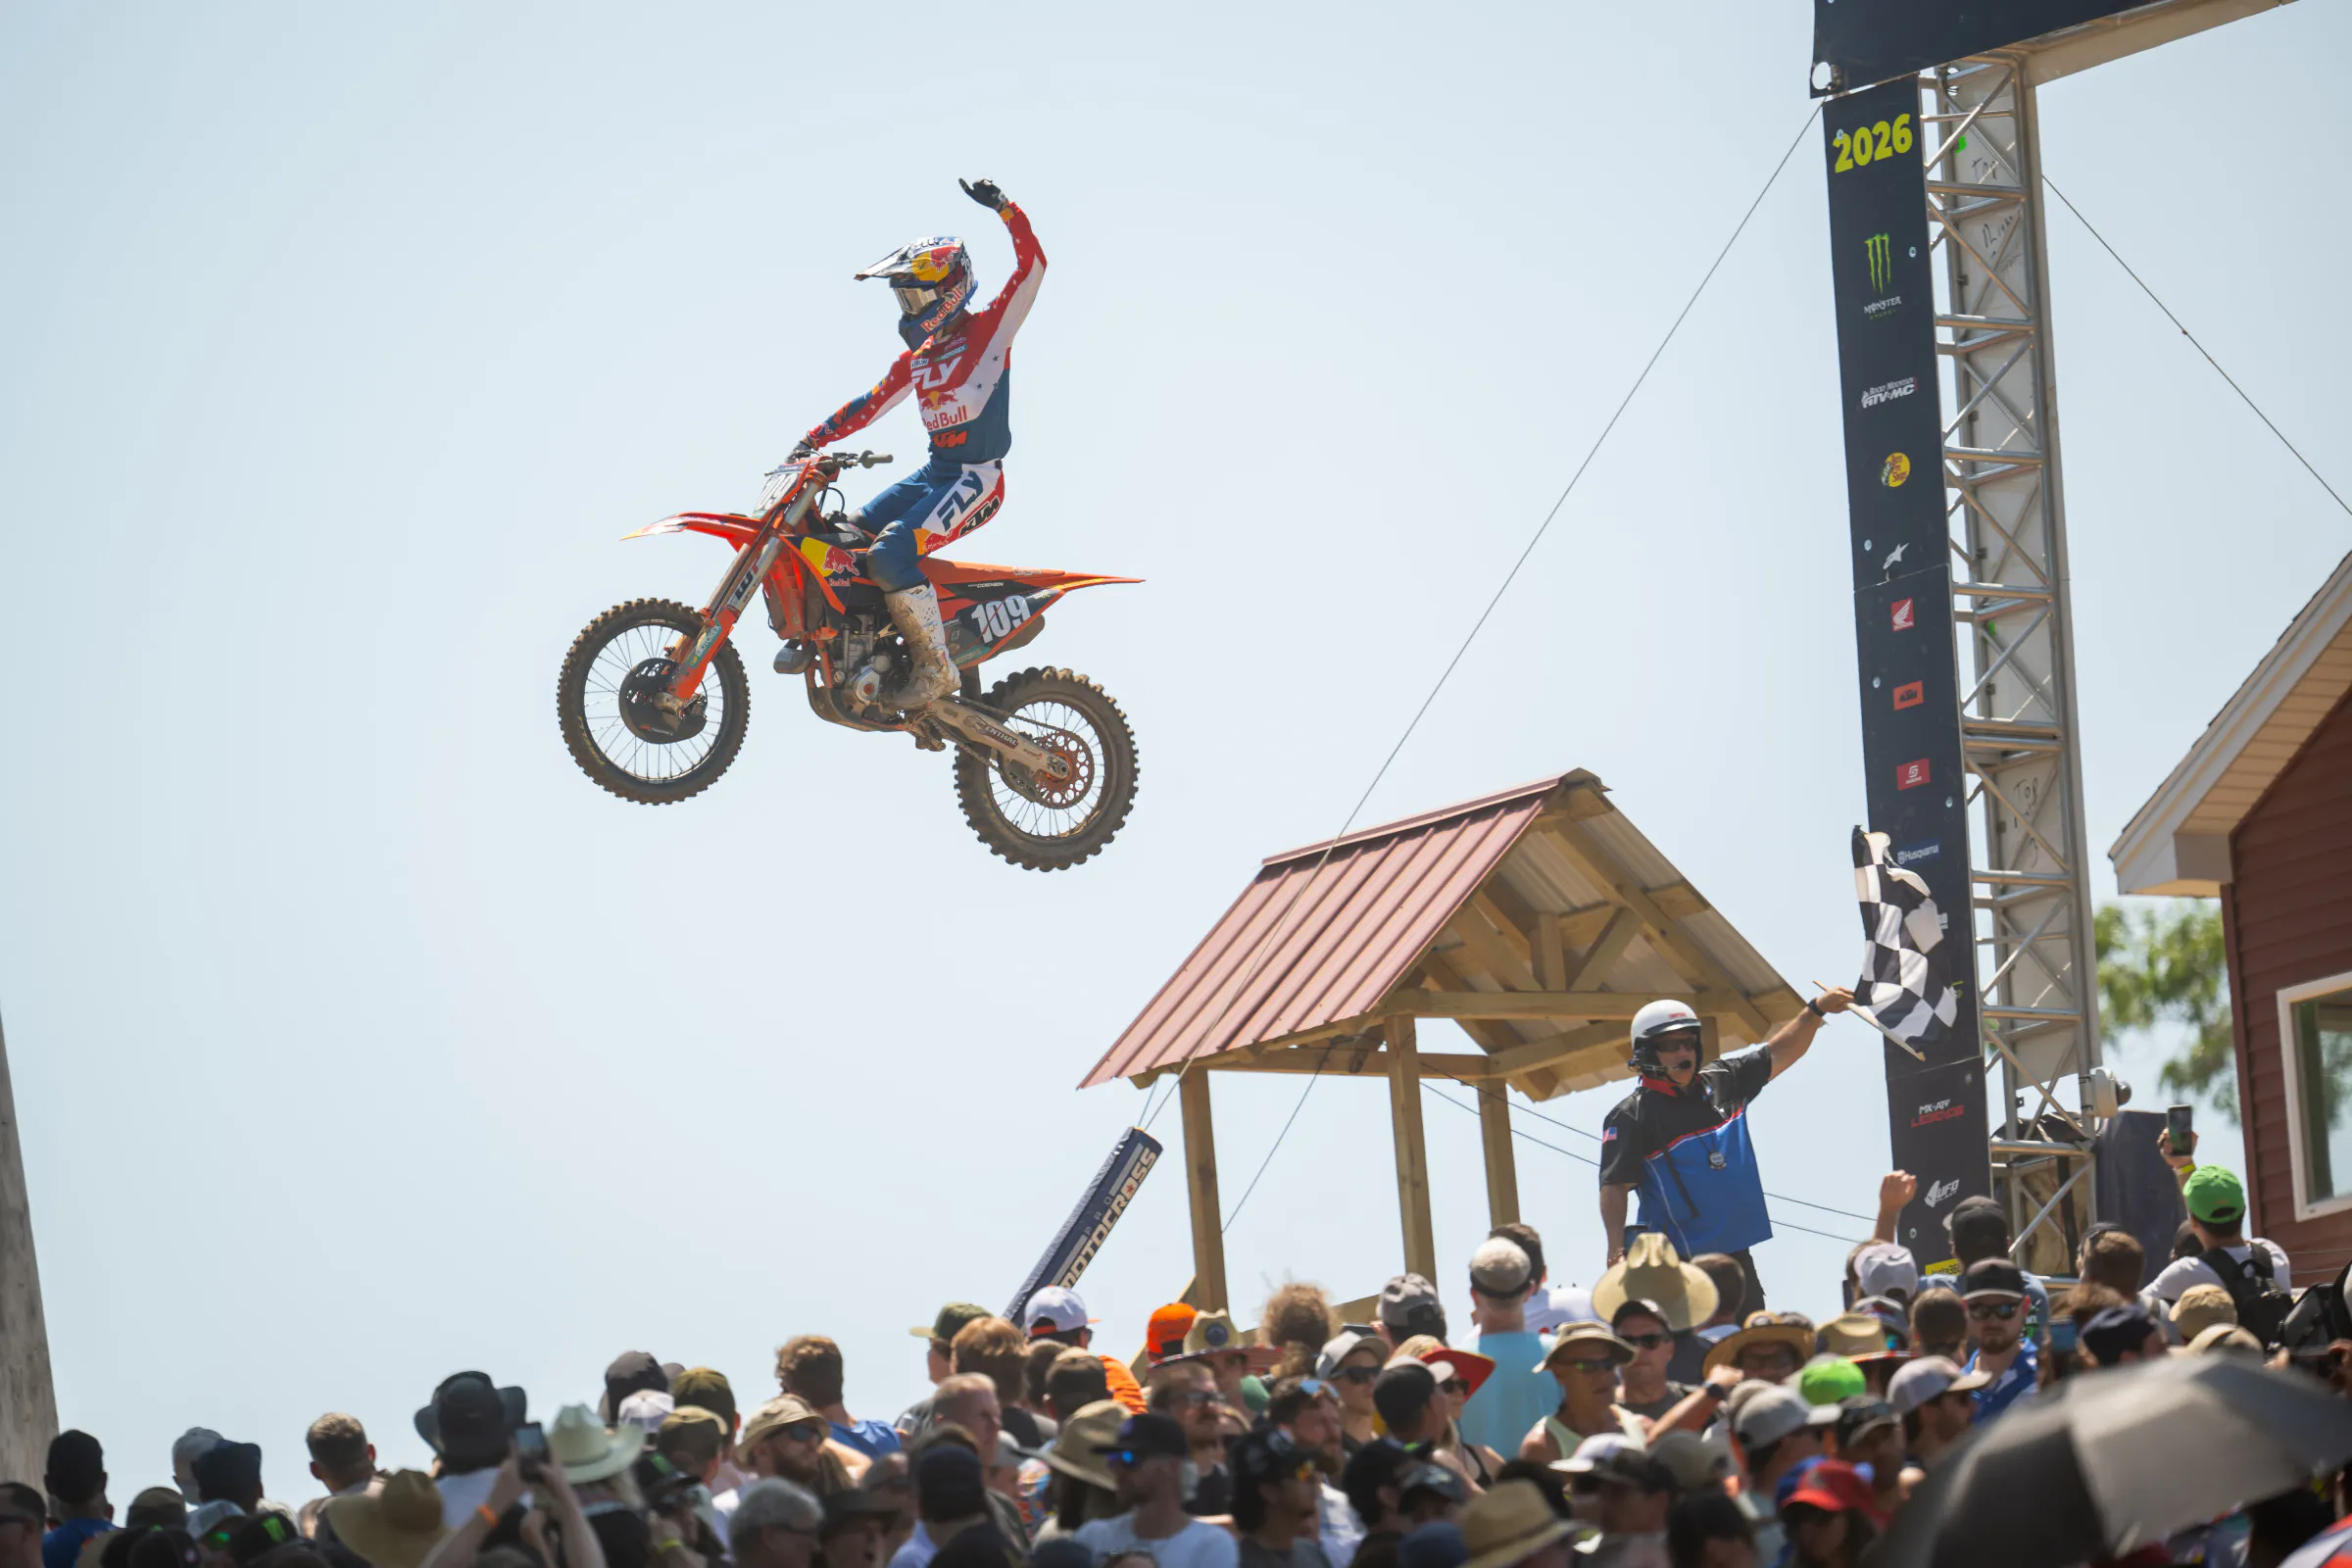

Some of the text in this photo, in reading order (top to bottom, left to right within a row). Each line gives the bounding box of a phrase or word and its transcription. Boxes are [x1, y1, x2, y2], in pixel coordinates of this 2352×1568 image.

[1833, 113, 1913, 173] 2026
[921, 307, 947, 333] Red
[942, 286, 964, 313] Bull
[1863, 295, 1902, 315] MONSTER
[910, 356, 963, 390] FLY
[939, 405, 968, 428] Bull
[932, 429, 968, 448] KTM
[936, 470, 984, 532] FLY
[959, 496, 1000, 536] KTM
[970, 594, 1031, 644] 109
[695, 624, 719, 658] MOTOREX
[1936, 1179, 1960, 1199] UFO
[1058, 1147, 1156, 1291] MOTOCROSS
[1084, 1196, 1111, 1236] PRO
